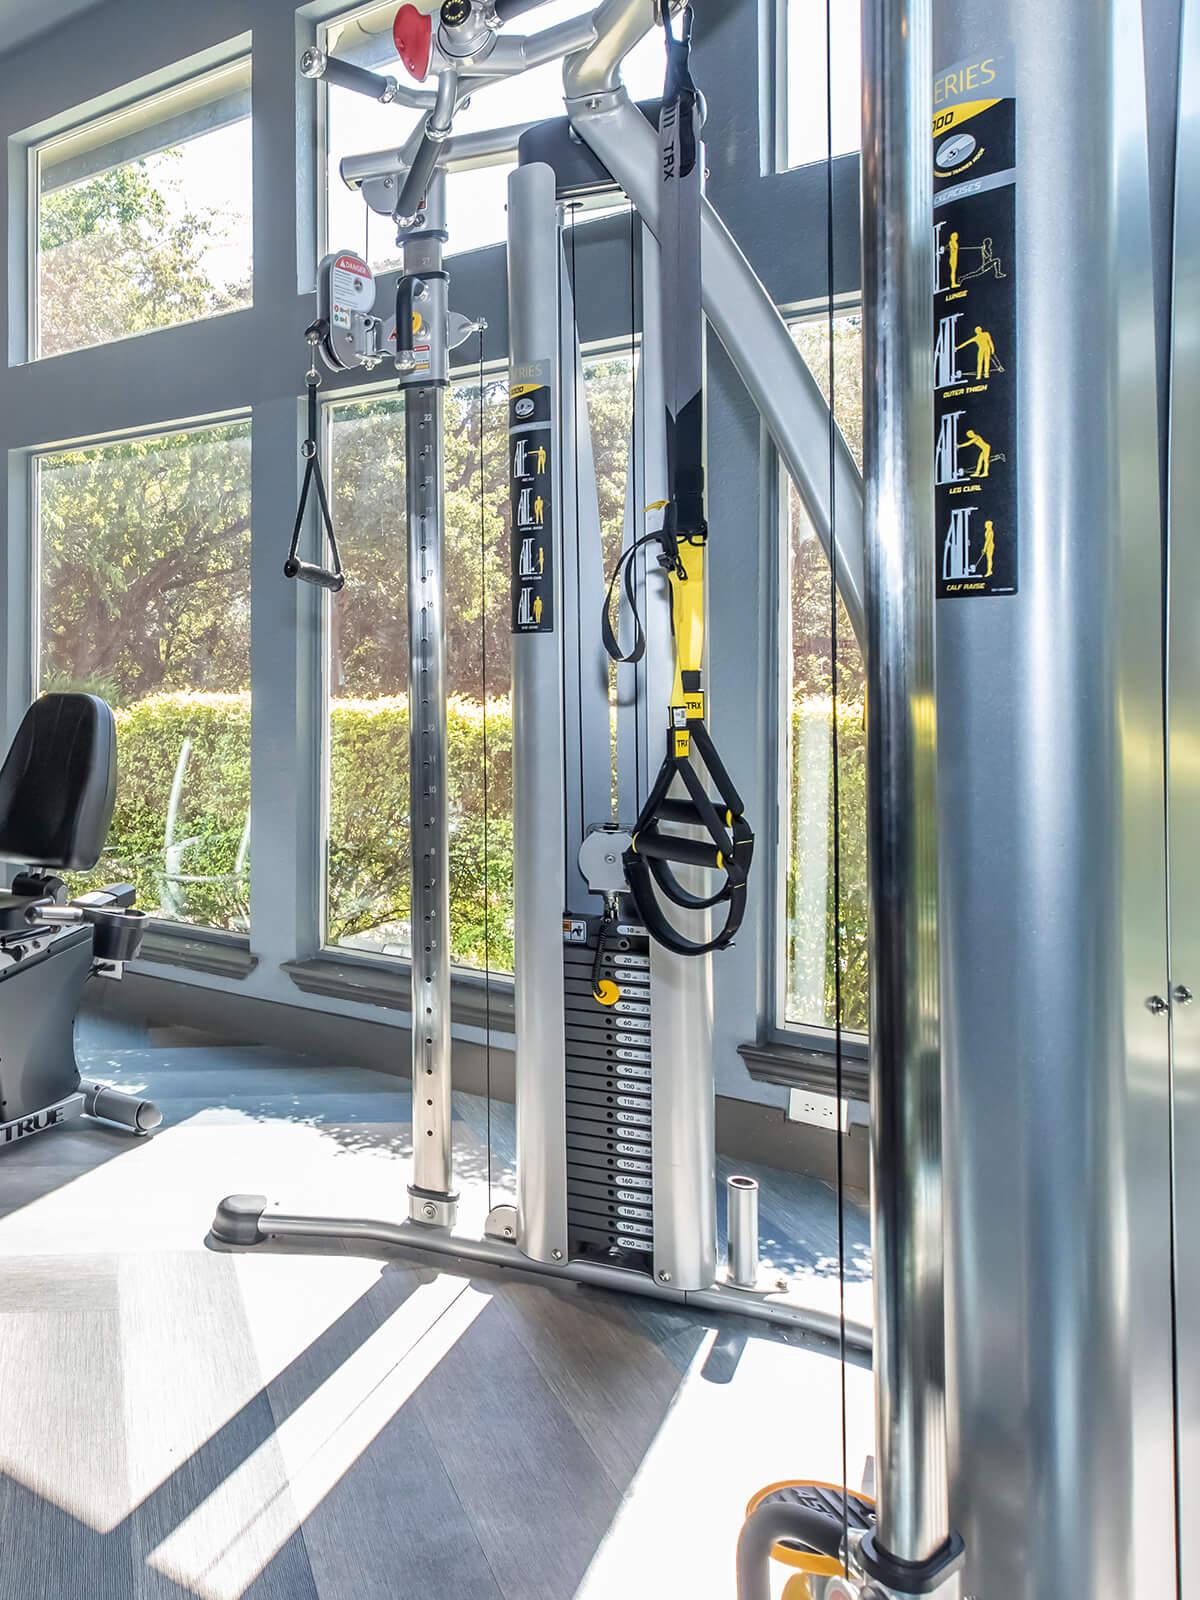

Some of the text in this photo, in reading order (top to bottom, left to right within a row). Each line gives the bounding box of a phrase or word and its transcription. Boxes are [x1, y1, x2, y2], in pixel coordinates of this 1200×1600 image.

[934, 59, 996, 104] ERIES
[663, 141, 674, 182] TRX
[943, 384, 988, 399] OUTER THIGH
[424, 413, 433, 422] 22
[949, 486, 962, 494] LEG
[686, 702, 702, 710] TRX
[0, 1107, 64, 1142] TRUE
